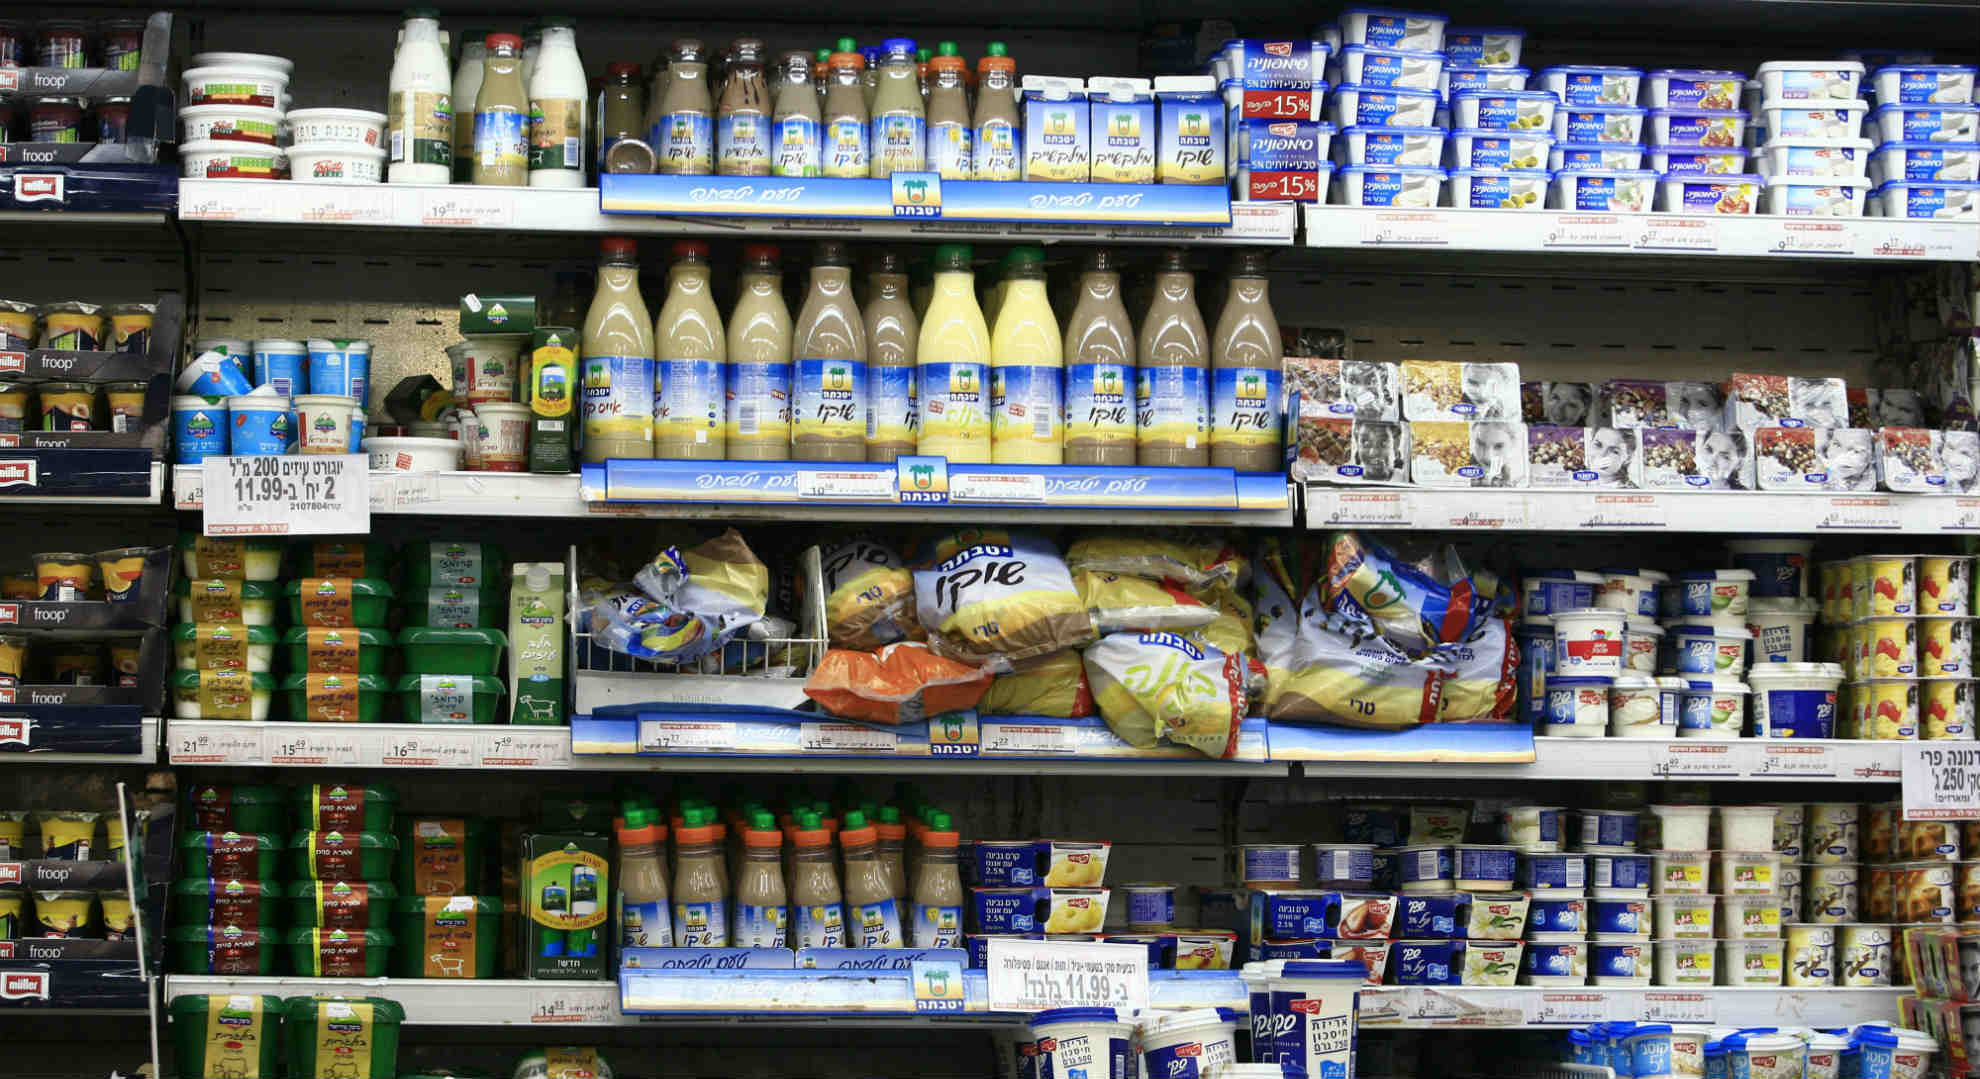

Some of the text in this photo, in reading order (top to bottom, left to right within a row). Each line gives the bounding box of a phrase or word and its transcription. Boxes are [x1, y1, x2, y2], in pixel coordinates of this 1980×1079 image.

[41, 356, 73, 371] froop
[254, 458, 279, 476] 200
[282, 460, 309, 477] עיזים
[313, 460, 344, 475] יוגורט
[324, 477, 336, 499] 2
[939, 544, 1010, 572] יטבתה
[936, 561, 1027, 613] שוקו
[34, 608, 66, 623] froop
[1942, 767, 1965, 791] 250
[37, 866, 69, 881] froop
[1066, 973, 1110, 1000] 11.99
[1312, 1019, 1348, 1031] אריזת
[1312, 1030, 1348, 1044] חיסכון
